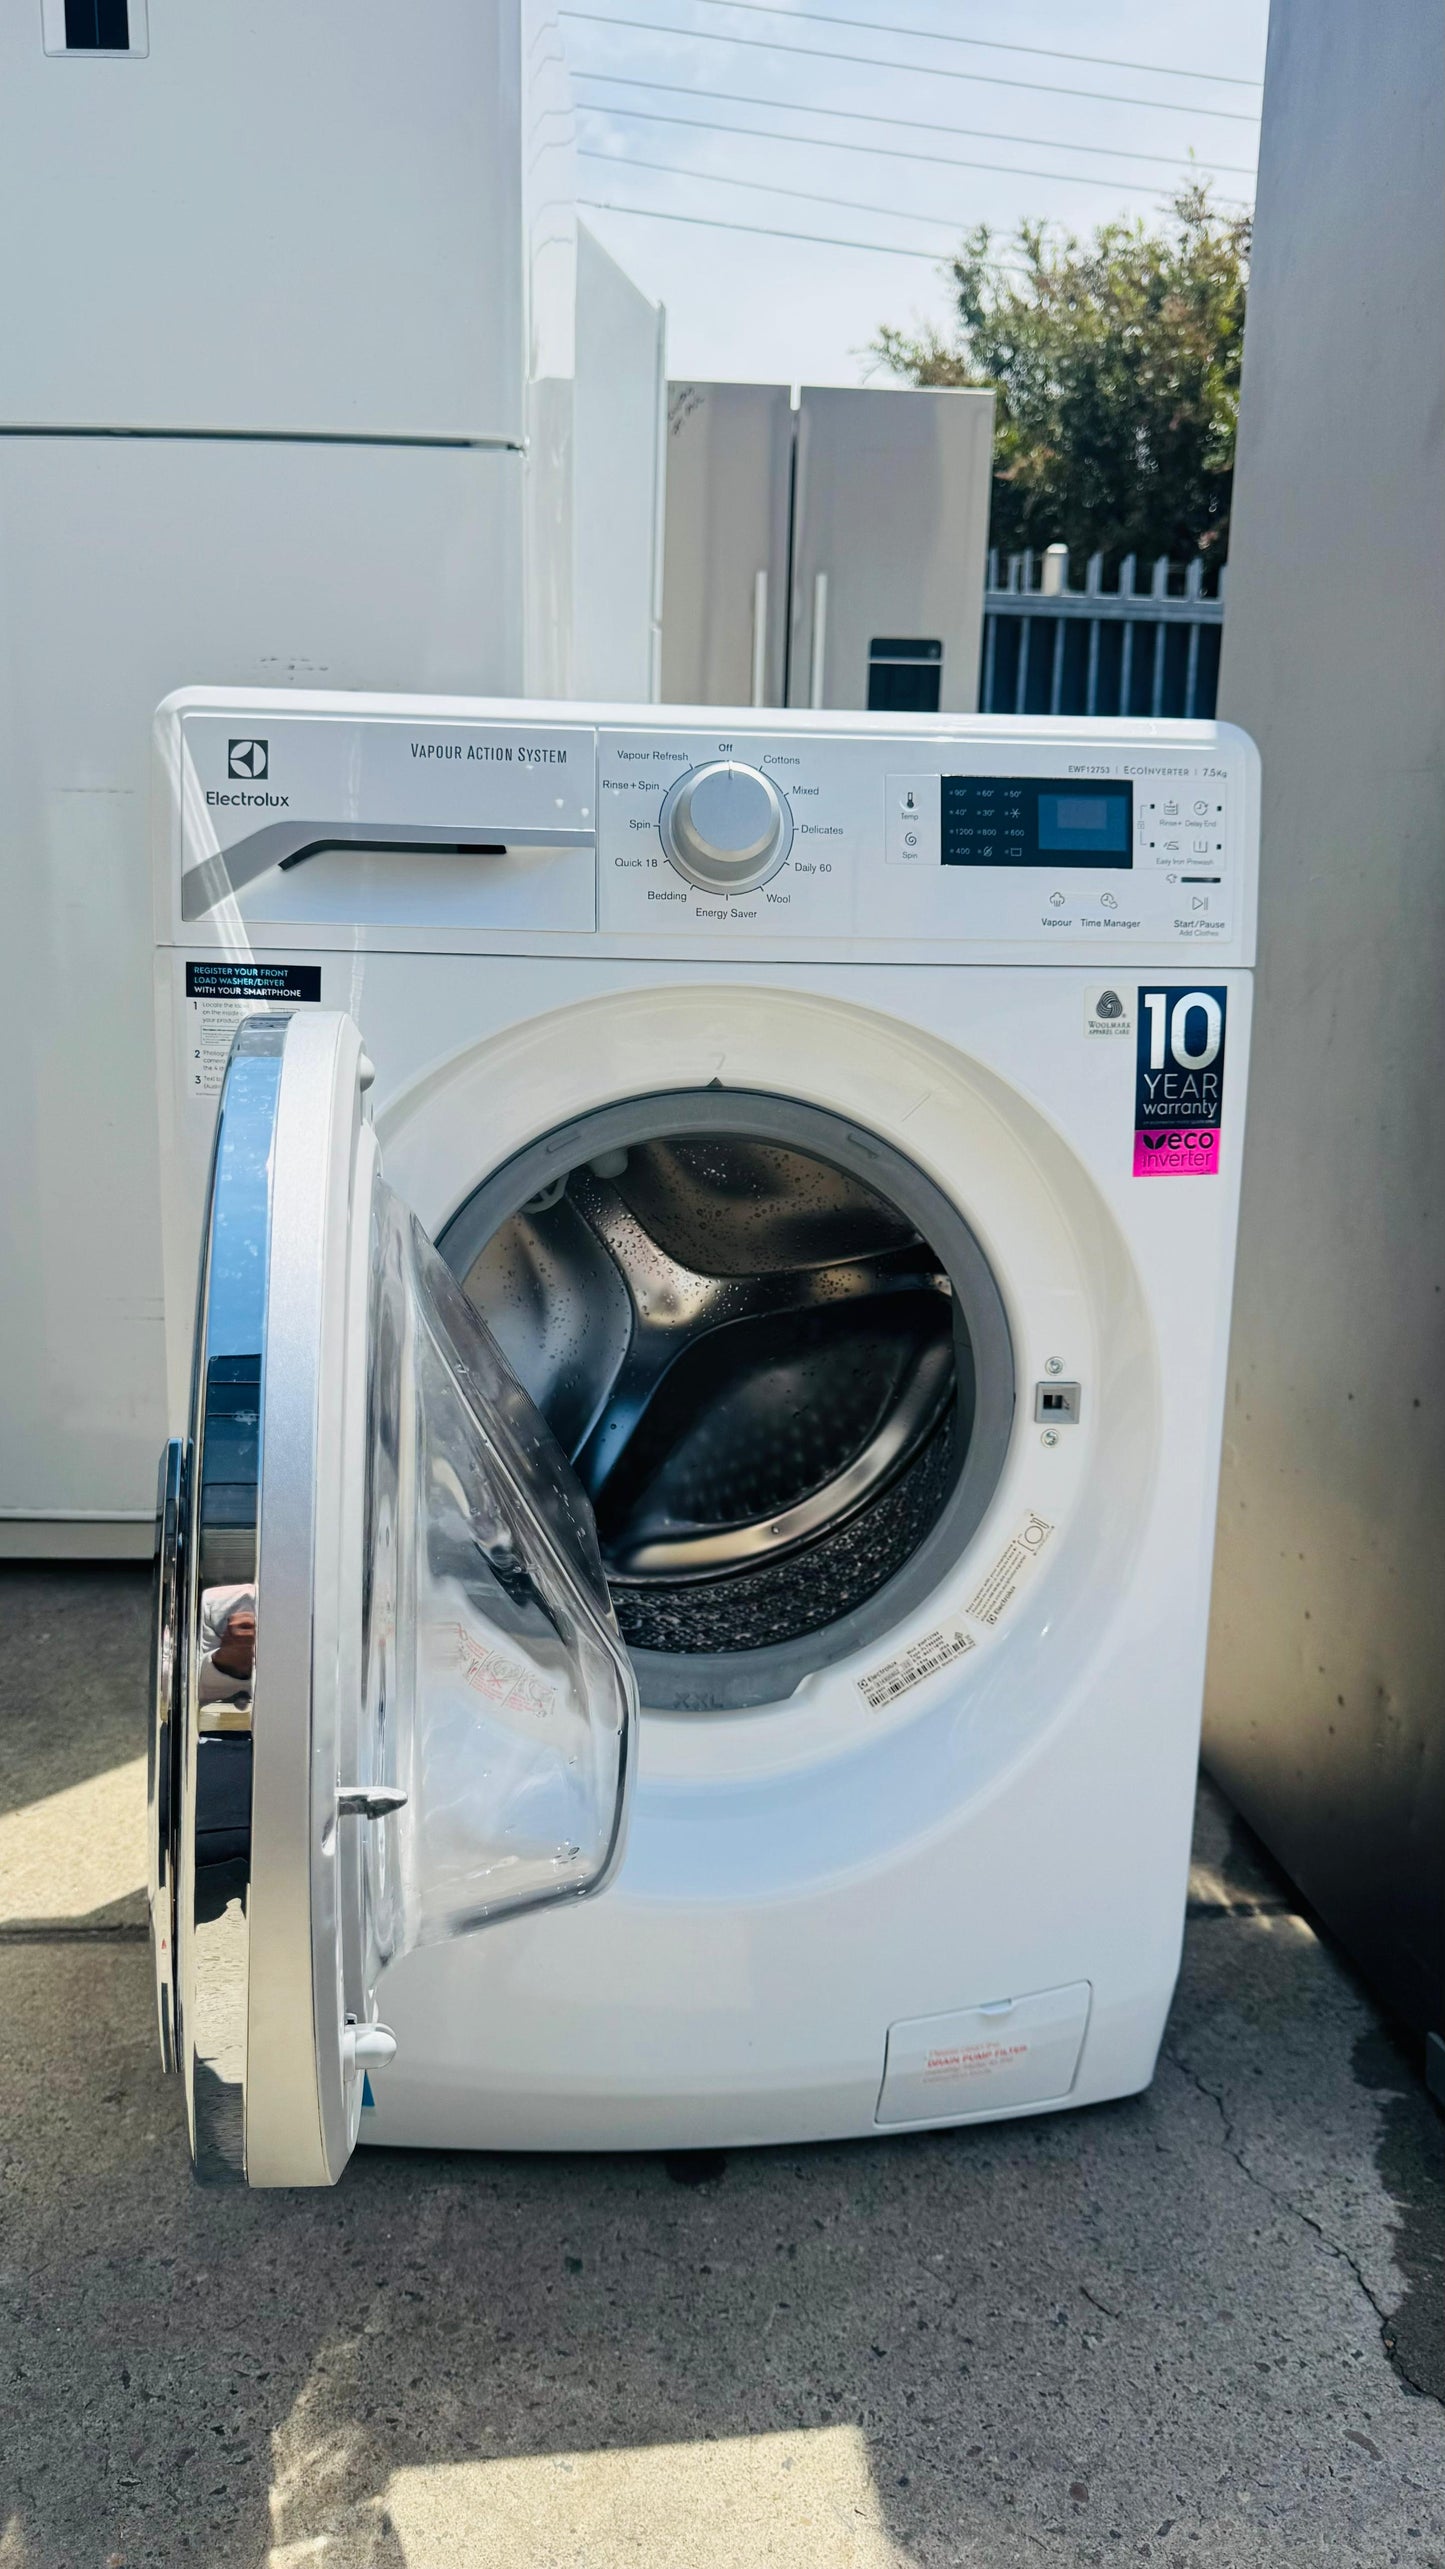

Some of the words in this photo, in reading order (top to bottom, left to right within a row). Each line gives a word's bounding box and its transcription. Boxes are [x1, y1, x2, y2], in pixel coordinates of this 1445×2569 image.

[410, 742, 462, 761] VAPOUR
[467, 745, 513, 762] ACTION
[517, 747, 568, 764] SYSTEM
[718, 743, 733, 753] Off
[617, 750, 650, 761] Vapour
[652, 751, 689, 761] Refresh
[763, 754, 801, 765] Cottons
[1068, 765, 1110, 774] EWF12753
[792, 786, 820, 796] Mixed
[205, 790, 290, 808] Electrolux
[900, 812, 919, 823] Temp
[629, 820, 651, 830] Spin
[1184, 819, 1203, 828] Delay
[800, 825, 844, 835] Delicates
[901, 851, 919, 860] Spin
[955, 847, 971, 855] 400
[614, 857, 642, 867] Quick
[645, 859, 658, 867] 18
[1156, 857, 1171, 866] Easy
[794, 862, 817, 874] Daily
[819, 863, 832, 873] 60
[647, 891, 687, 903] Bedding
[766, 894, 791, 904] Wool
[696, 907, 729, 919] Energy
[730, 909, 757, 919] Saver
[1041, 918, 1073, 928] Vapour
[1080, 918, 1101, 928] Time
[1103, 919, 1141, 929] Manager
[1173, 920, 1225, 929] Start/Pause
[194, 966, 233, 975] REGISTER
[234, 968, 258, 976] YOUR
[260, 969, 289, 977] FRONT
[194, 976, 217, 985] LOAD
[219, 977, 285, 987] WASHER/DRYER
[194, 986, 216, 994] WITH
[217, 987, 242, 995] YOUR
[243, 987, 302, 998] SMARTPHONE
[193, 1001, 198, 1010] 1
[1144, 991, 1222, 1070] 10
[194, 1049, 201, 1059] 2
[195, 1075, 202, 1084] 3
[1144, 1073, 1219, 1100] YEAR
[1143, 1099, 1218, 1119] warranty
[1167, 1132, 1214, 1150] eco
[1142, 1150, 1213, 1168] inverter
